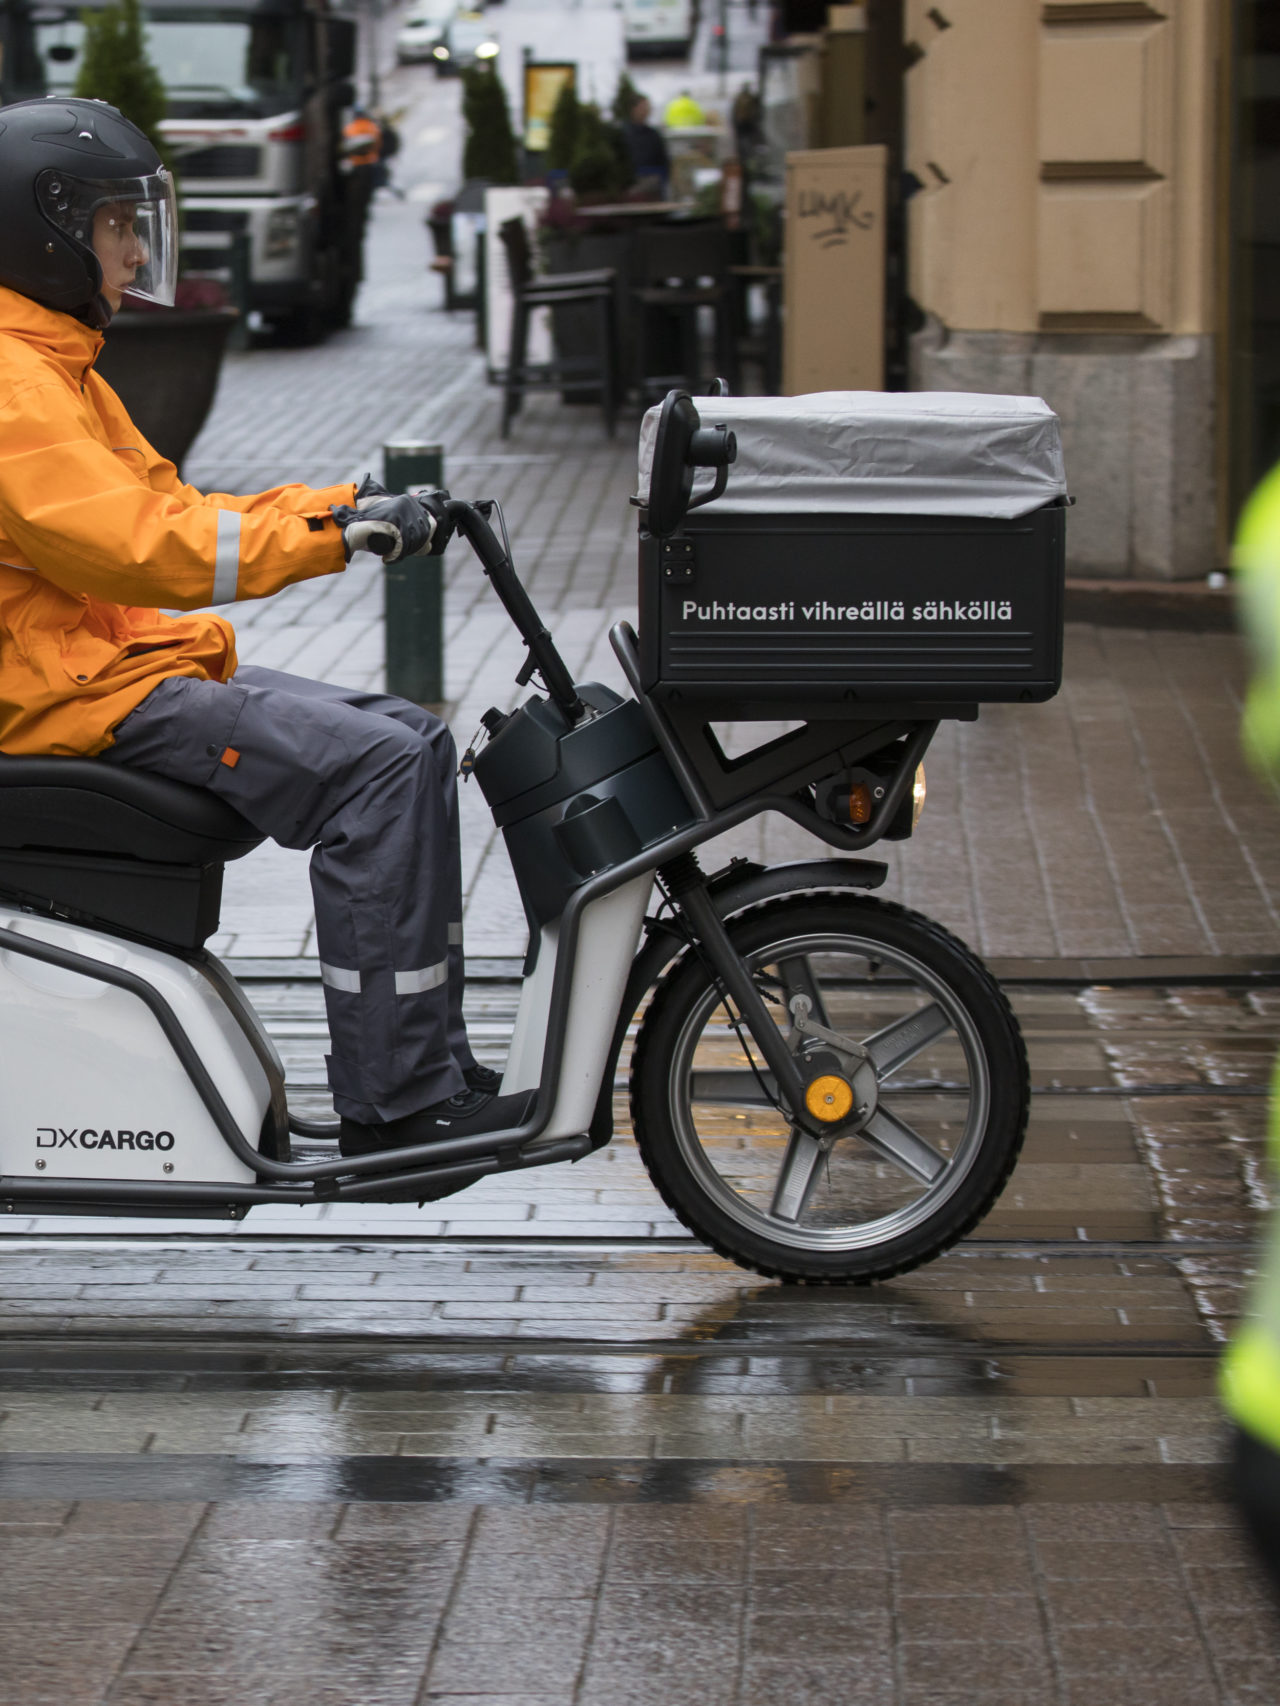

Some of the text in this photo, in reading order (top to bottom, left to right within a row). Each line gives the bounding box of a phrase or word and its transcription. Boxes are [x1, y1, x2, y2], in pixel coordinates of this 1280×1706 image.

[682, 600, 1012, 621] Puhtaasti vihreällä sähköllä
